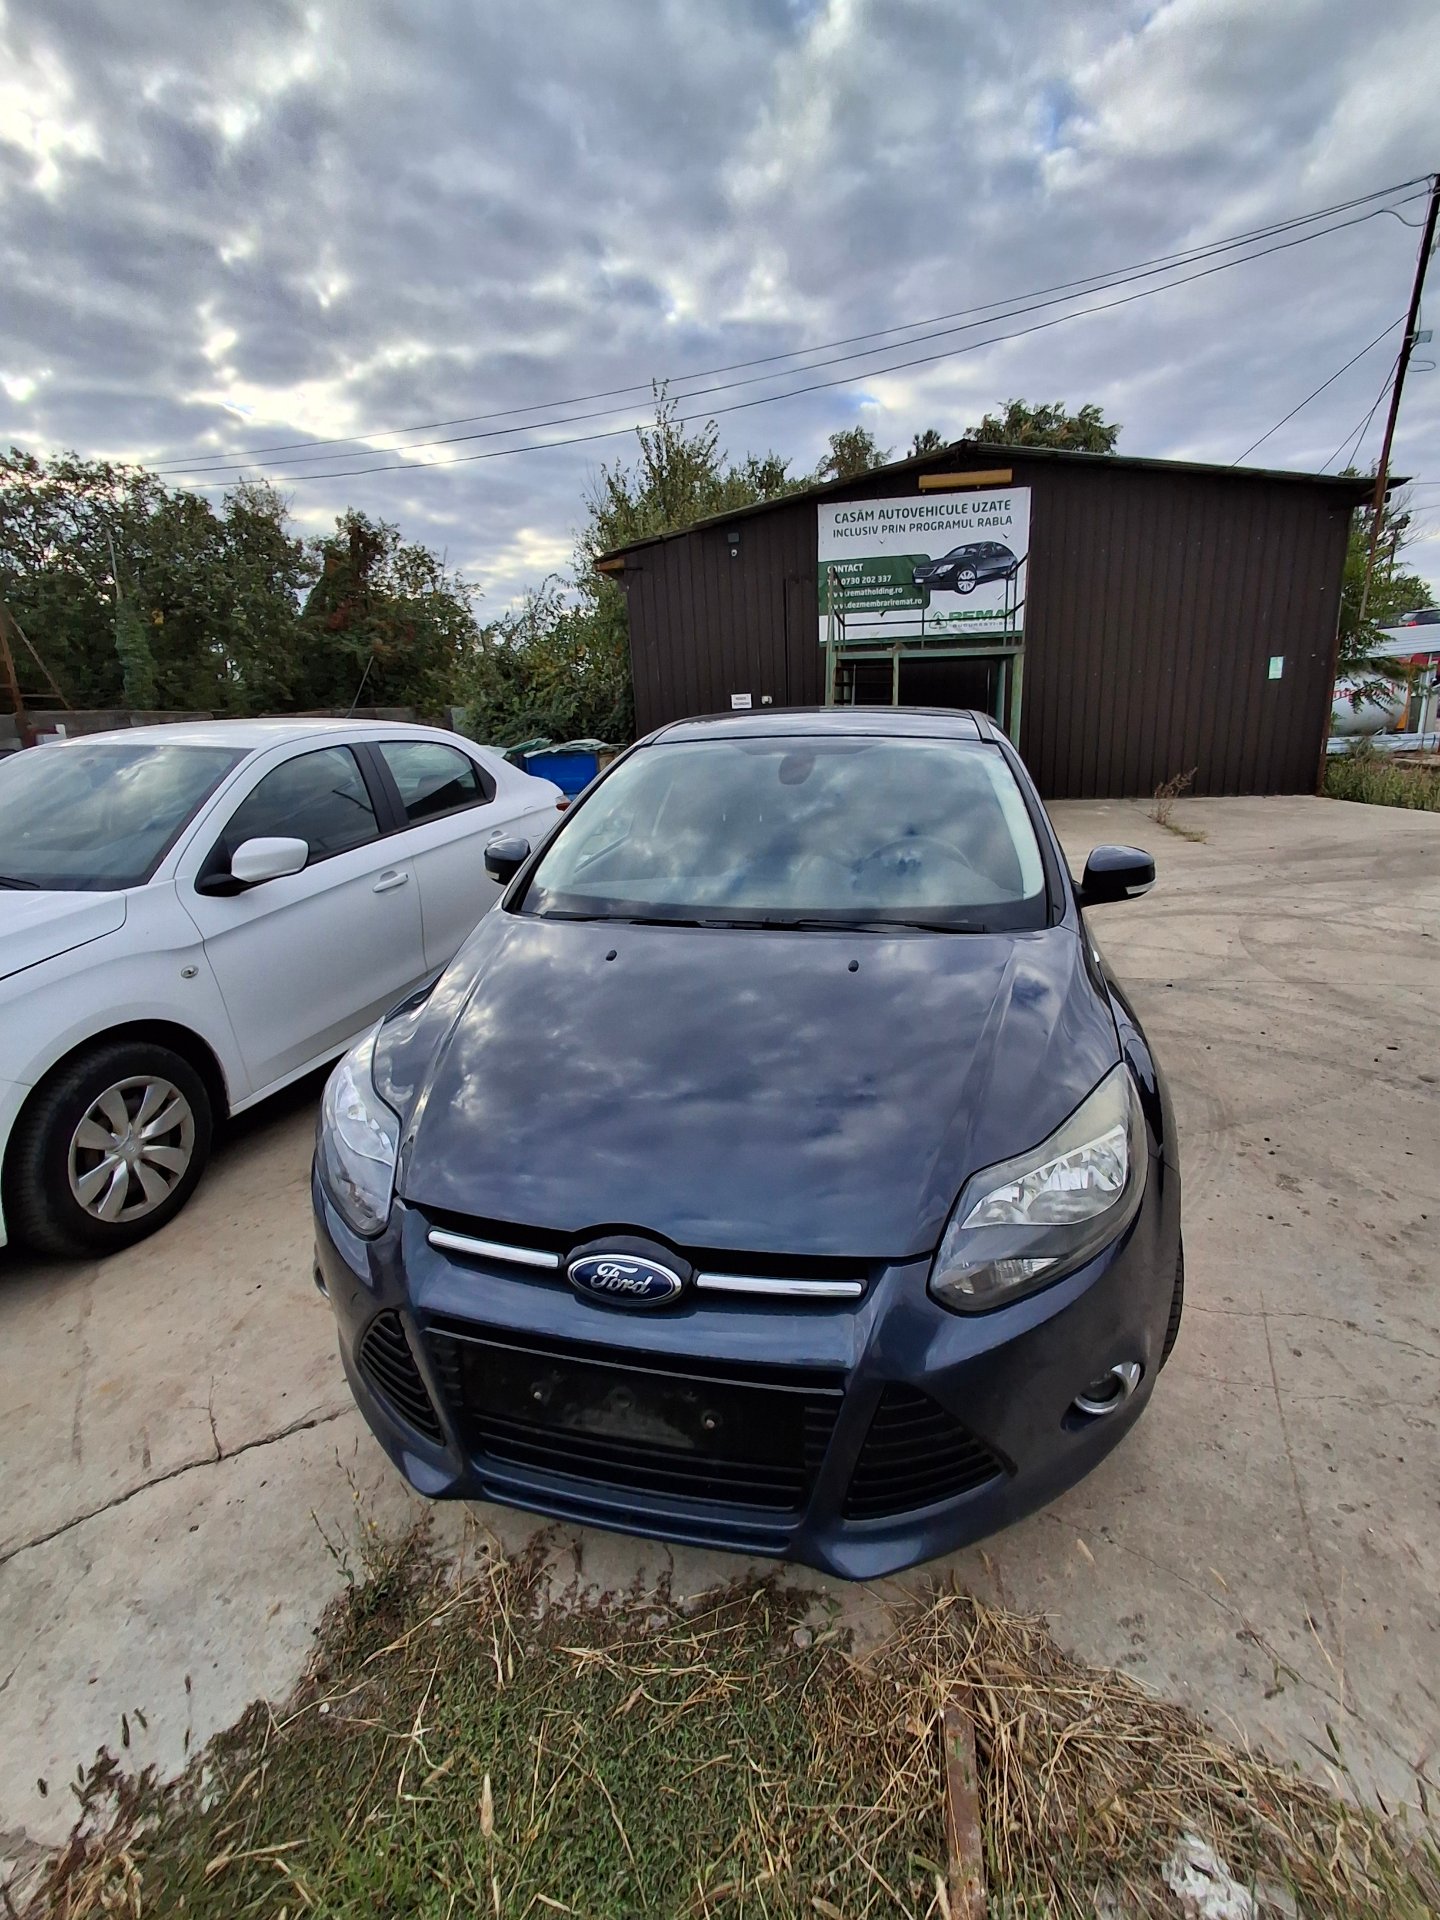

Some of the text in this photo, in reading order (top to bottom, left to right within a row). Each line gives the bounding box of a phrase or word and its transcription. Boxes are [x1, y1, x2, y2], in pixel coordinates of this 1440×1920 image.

[834, 499, 1011, 524] CASĂM AUTOVEHICULE UZATE
[832, 515, 1012, 538] INCLUSIV PRIN PROGRAMUL RABLA
[841, 577, 860, 586] 0730
[861, 575, 876, 584] 202
[878, 574, 892, 583] 337
[827, 598, 923, 610] ww.dezmembrariremat.ro
[590, 1263, 653, 1295] Ford
